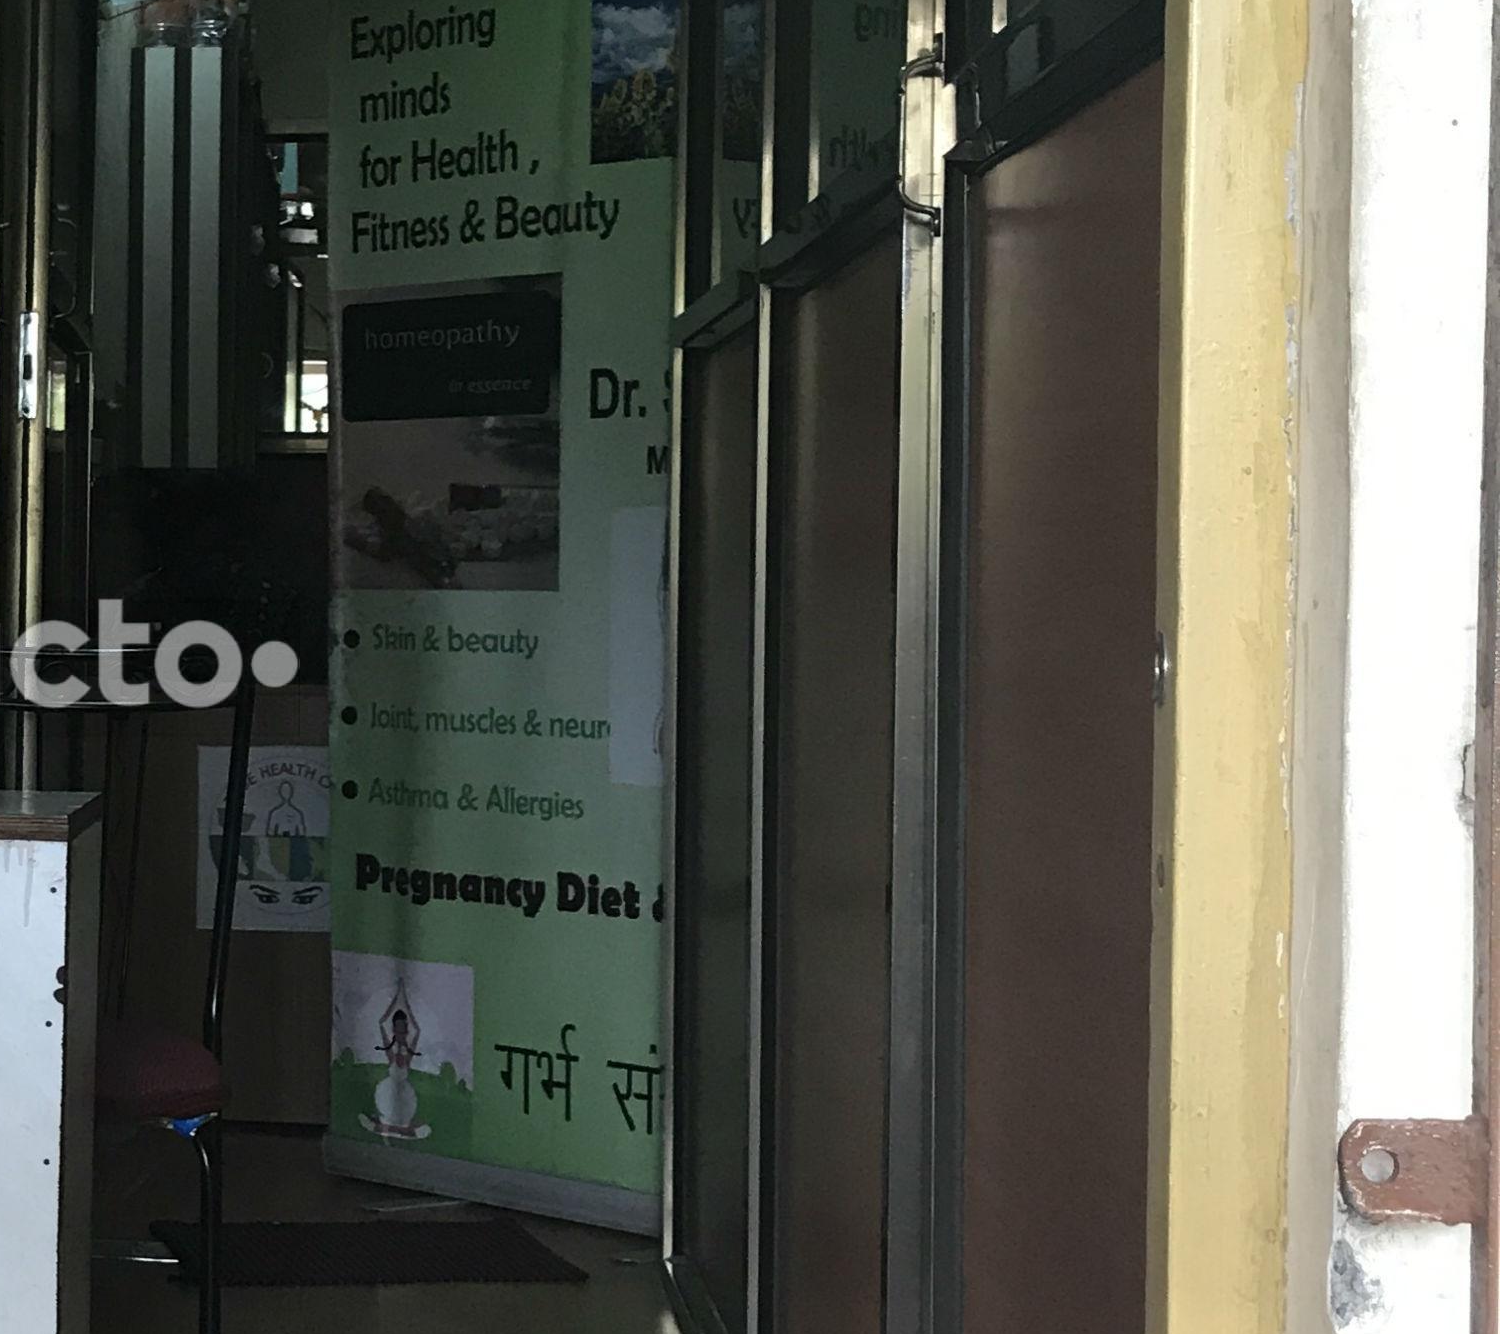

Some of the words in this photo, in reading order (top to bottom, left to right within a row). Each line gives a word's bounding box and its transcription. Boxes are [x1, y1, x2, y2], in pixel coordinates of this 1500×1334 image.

[350, 6, 496, 64] Exploring
[359, 71, 451, 124] minds
[360, 145, 402, 189] for
[351, 207, 450, 255] Fitness
[460, 198, 486, 245] &
[494, 189, 620, 241] Beauty
[364, 319, 521, 351] homeopathy
[467, 377, 532, 394] essence
[589, 368, 647, 419] Dr.
[371, 623, 417, 653] Skin
[422, 625, 440, 652] &
[447, 624, 539, 660] beauty
[425, 705, 517, 736] muscles
[523, 709, 543, 738] &
[549, 714, 611, 741] neur
[259, 762, 318, 780] HEALTH
[367, 777, 449, 811] Asthma
[457, 783, 479, 812] &
[485, 783, 585, 822] Allergies
[355, 853, 546, 918] Pregnancy
[556, 871, 641, 920] Diet
[494, 1023, 580, 1122] गर्भ
